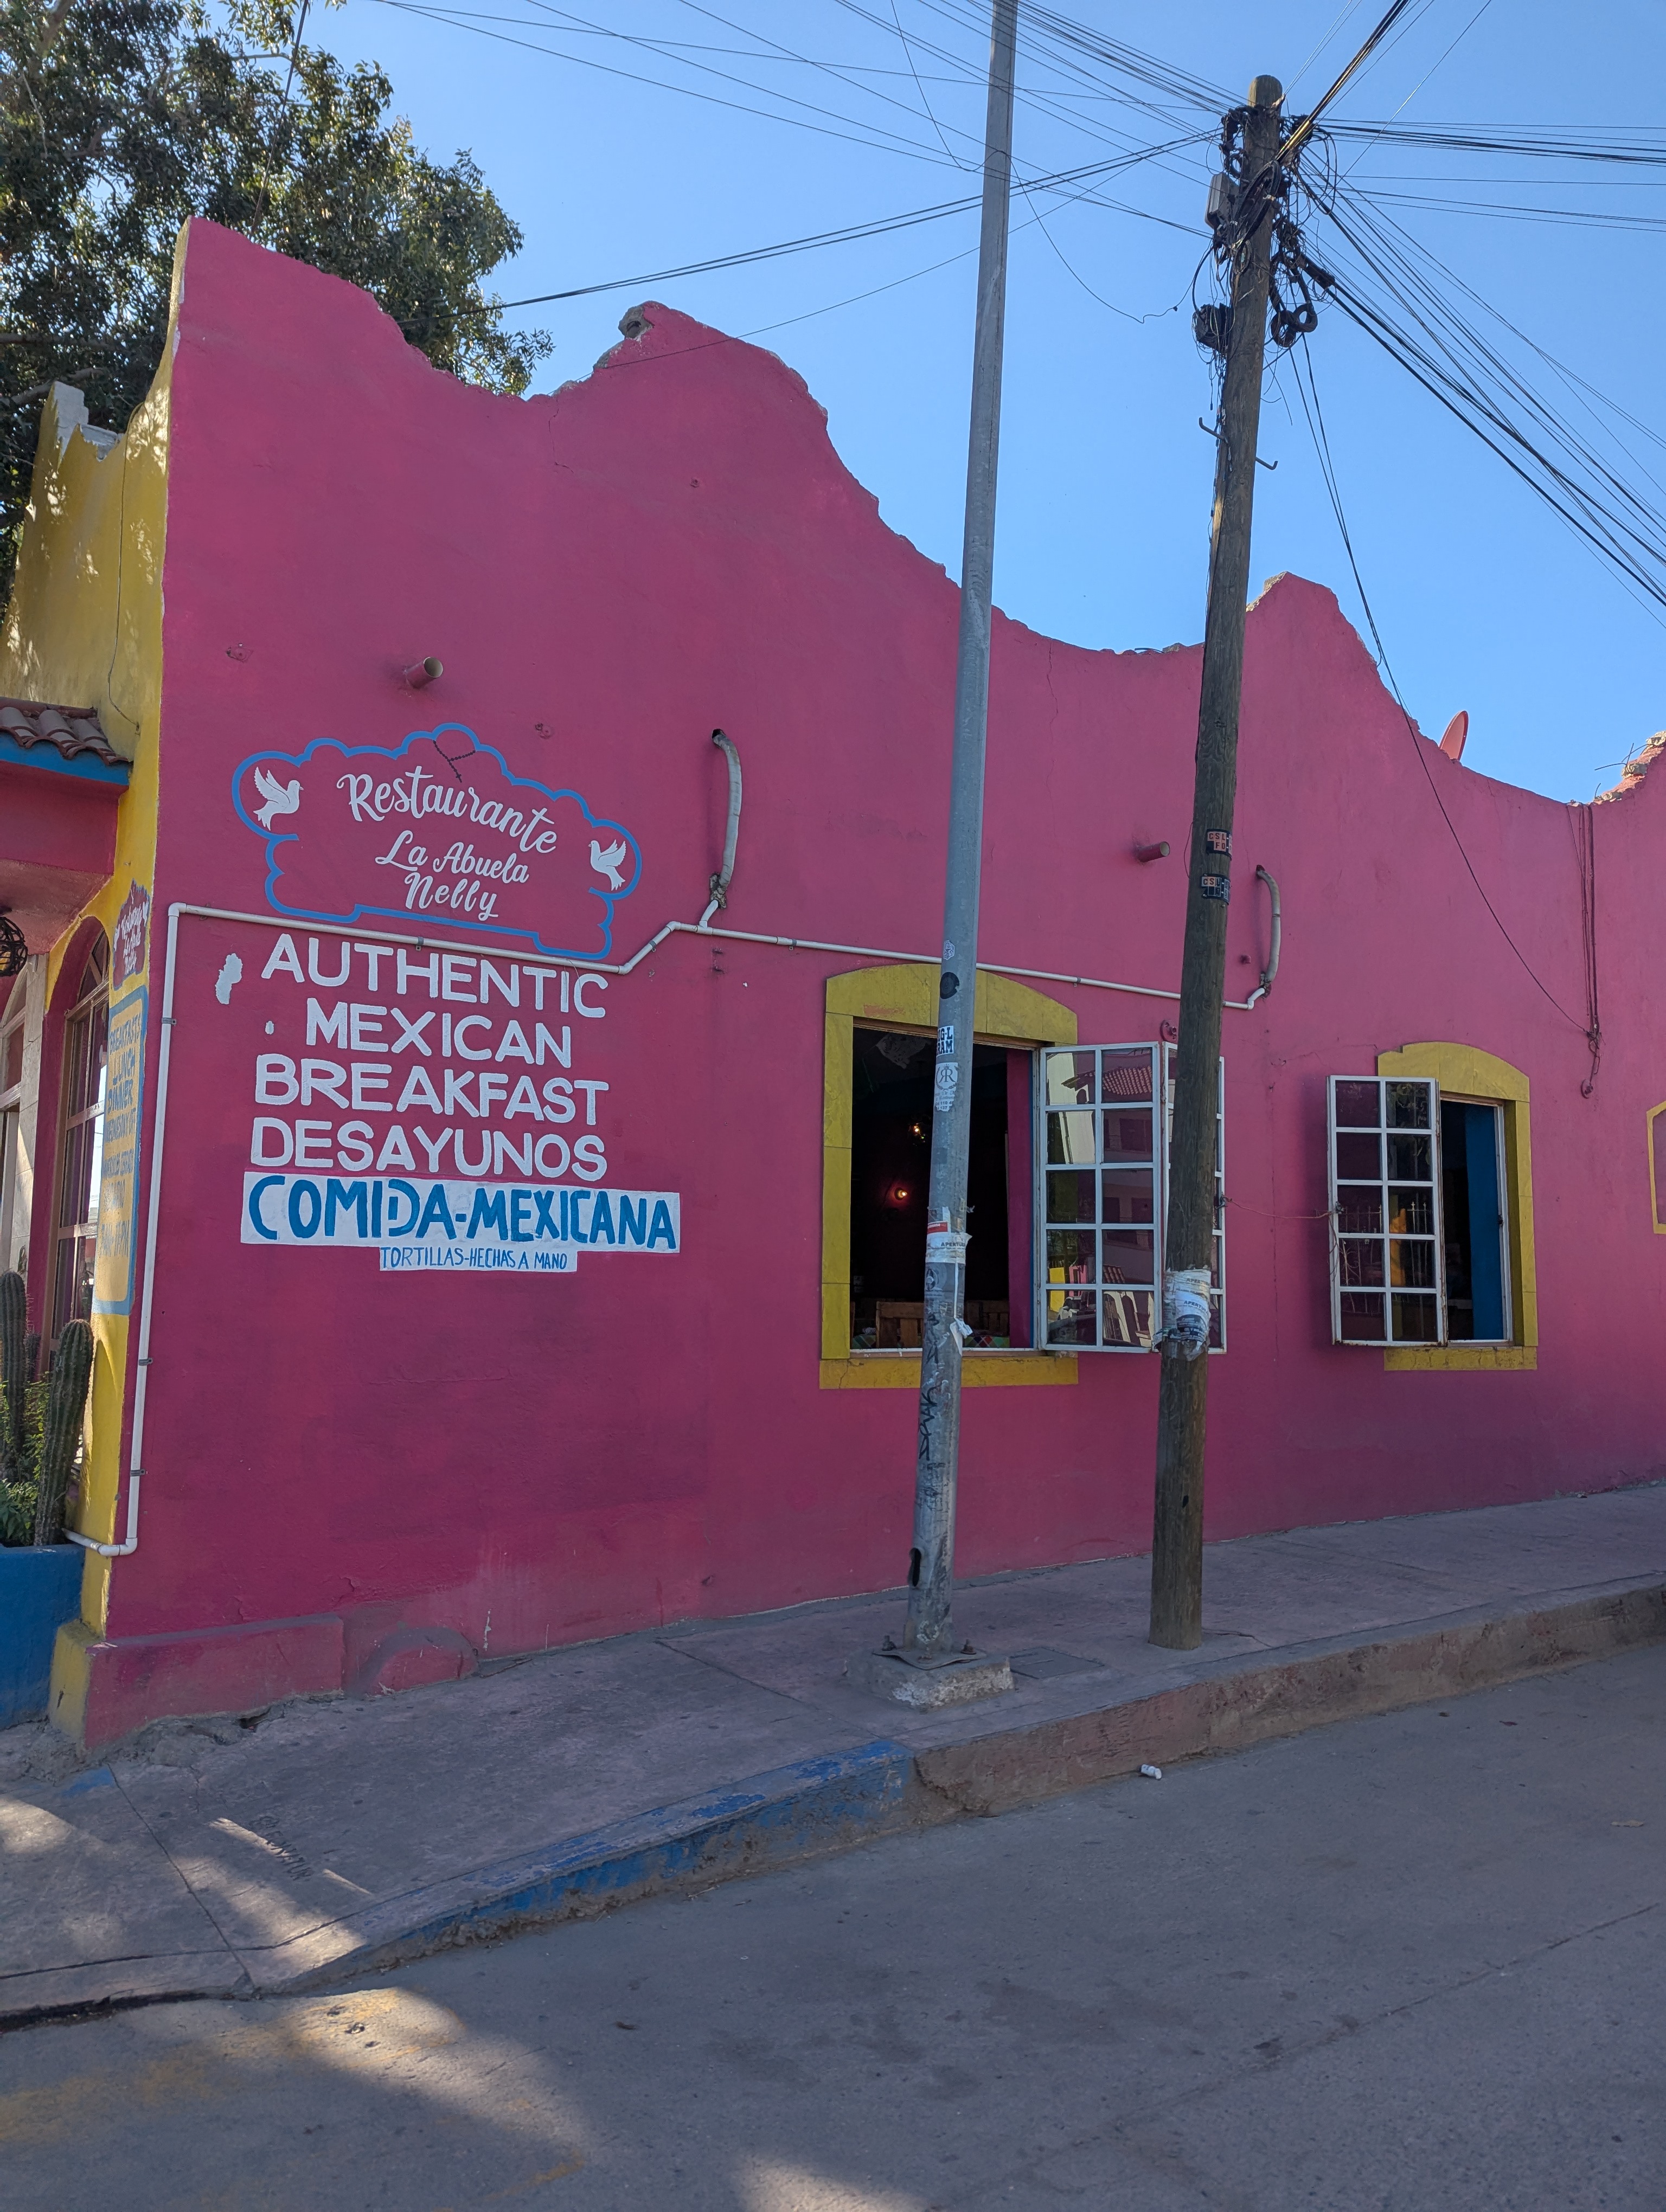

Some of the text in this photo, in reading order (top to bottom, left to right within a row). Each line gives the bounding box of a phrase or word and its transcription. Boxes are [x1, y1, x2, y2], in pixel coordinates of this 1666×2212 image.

[336, 766, 557, 853] Restaurante
[375, 830, 529, 884] La Abuela
[405, 872, 498, 921] Nelly
[260, 933, 608, 1018] AUTHENTIC
[306, 997, 571, 1068] MEXICAN
[108, 1078, 133, 1114] DINNER
[113, 1046, 135, 1085] LUNCH
[255, 1054, 608, 1126] BREAKFAST
[251, 1116, 607, 1181] DESAYUNOS
[248, 1175, 677, 1249] COMIDA-MEXICANA
[381, 1246, 567, 1270] TORTILLAS-HECHAS A MANO
